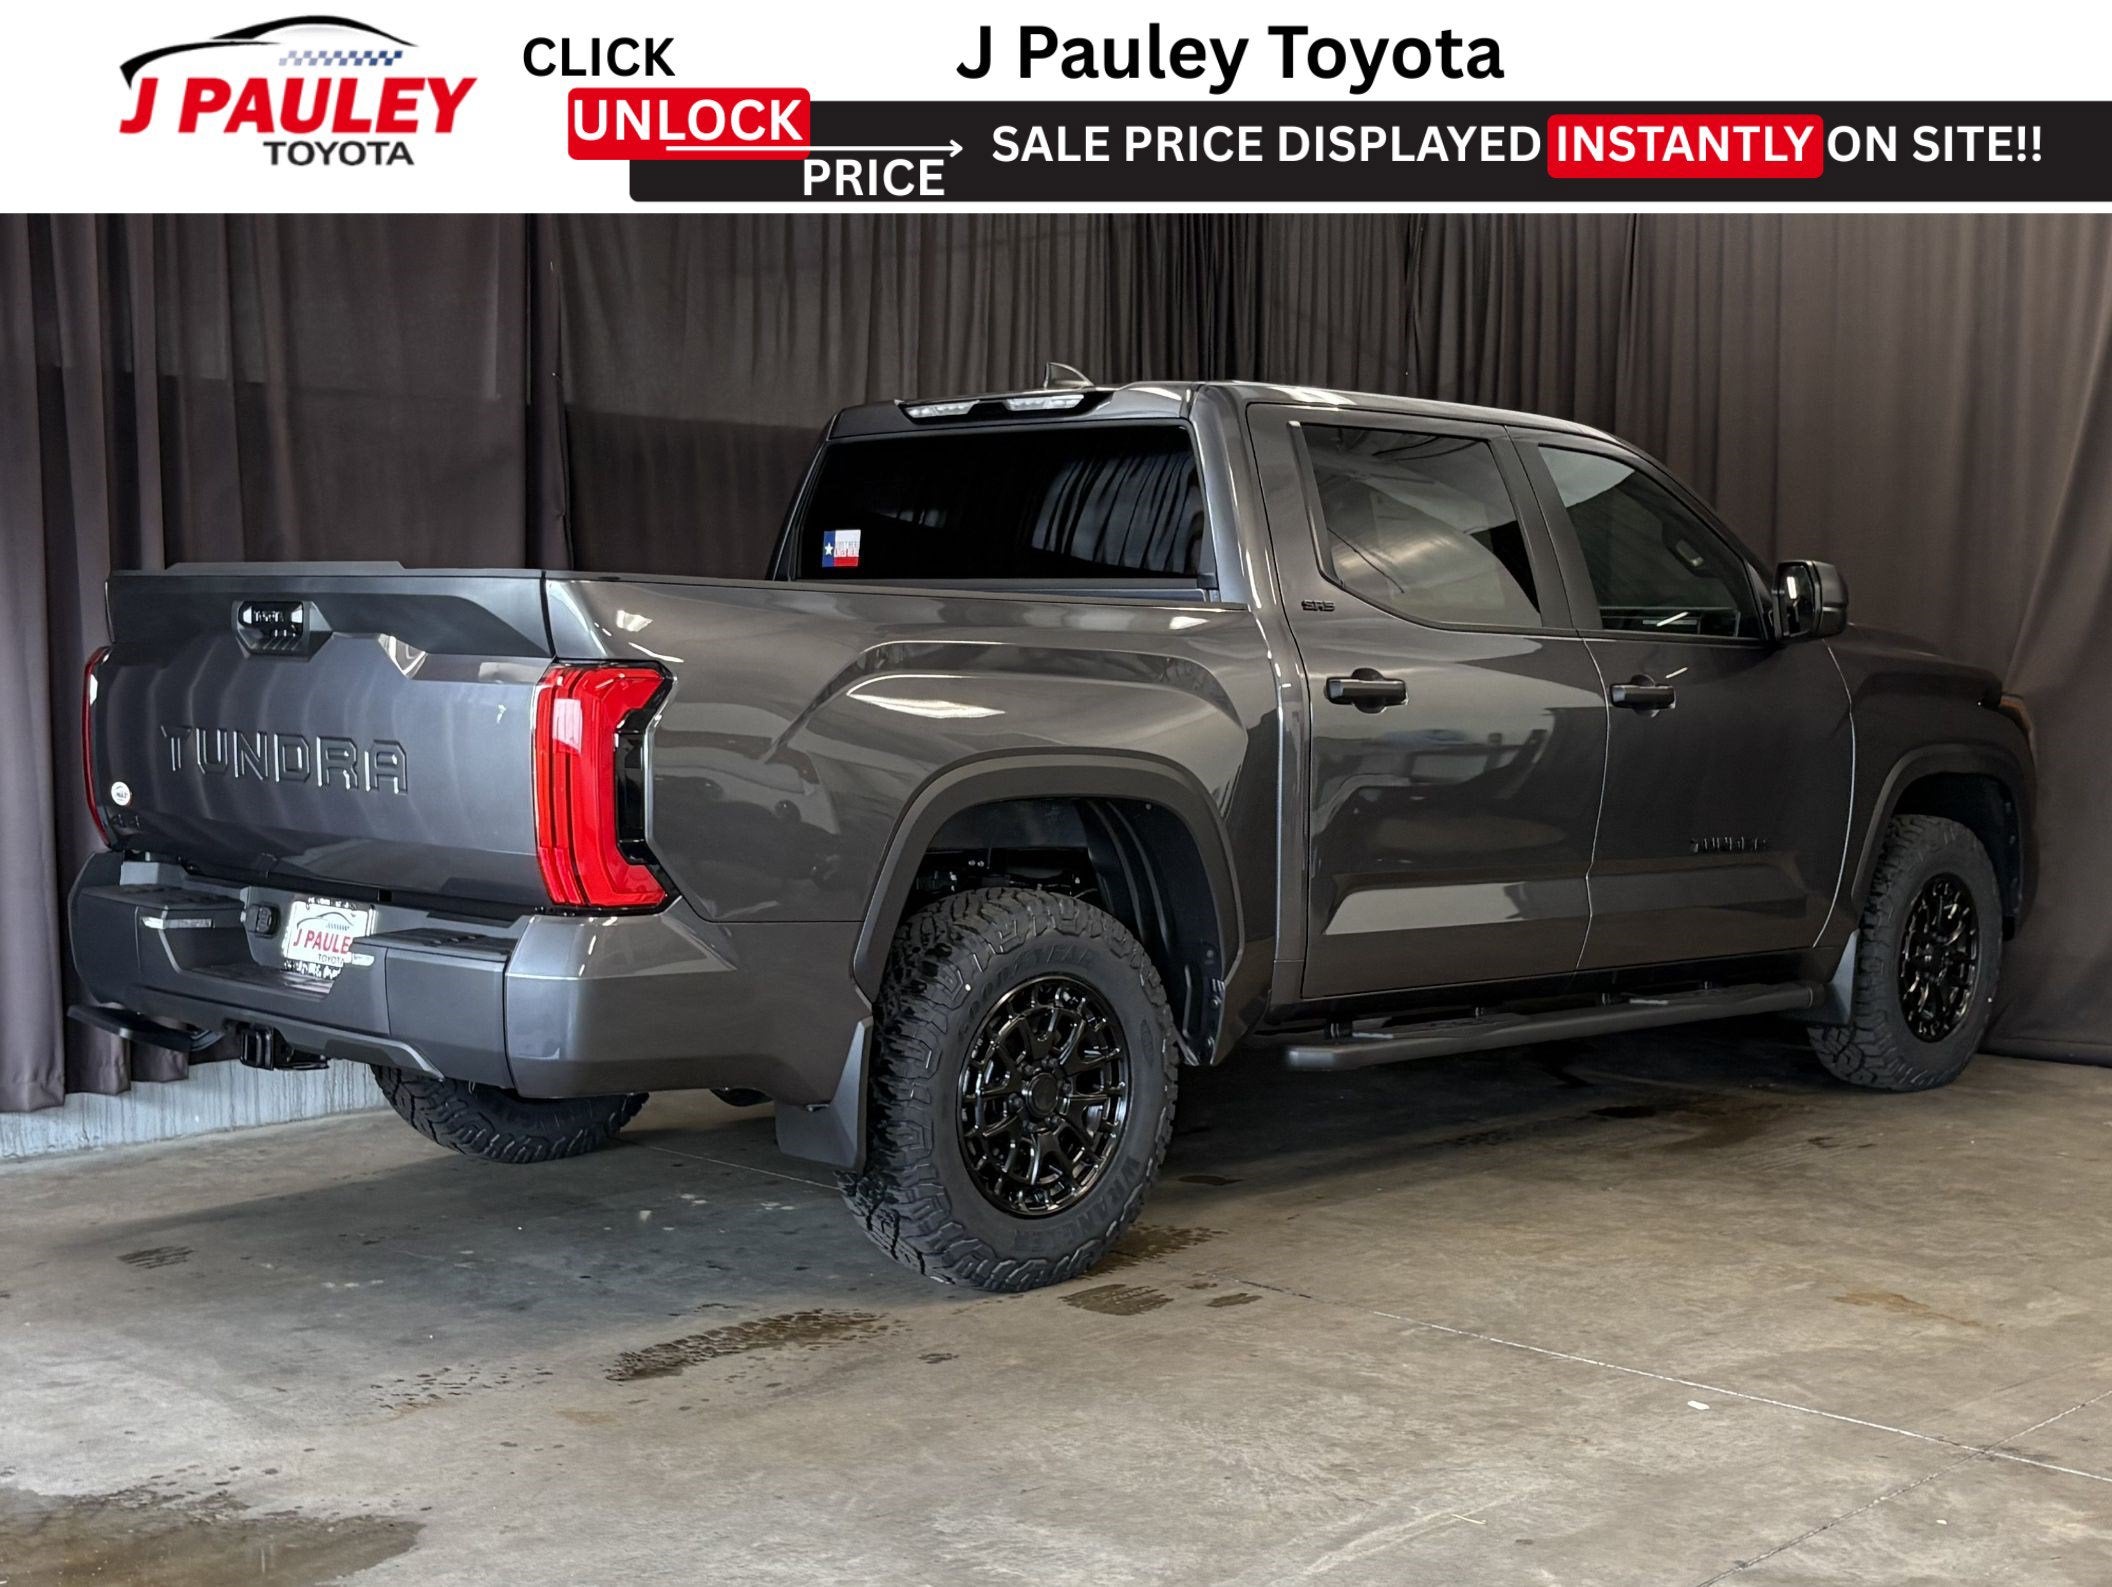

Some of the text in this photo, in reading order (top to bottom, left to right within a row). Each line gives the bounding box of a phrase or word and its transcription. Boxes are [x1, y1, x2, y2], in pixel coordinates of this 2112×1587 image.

[160, 724, 409, 796] TUNDRA
[293, 927, 353, 955] J PAULE
